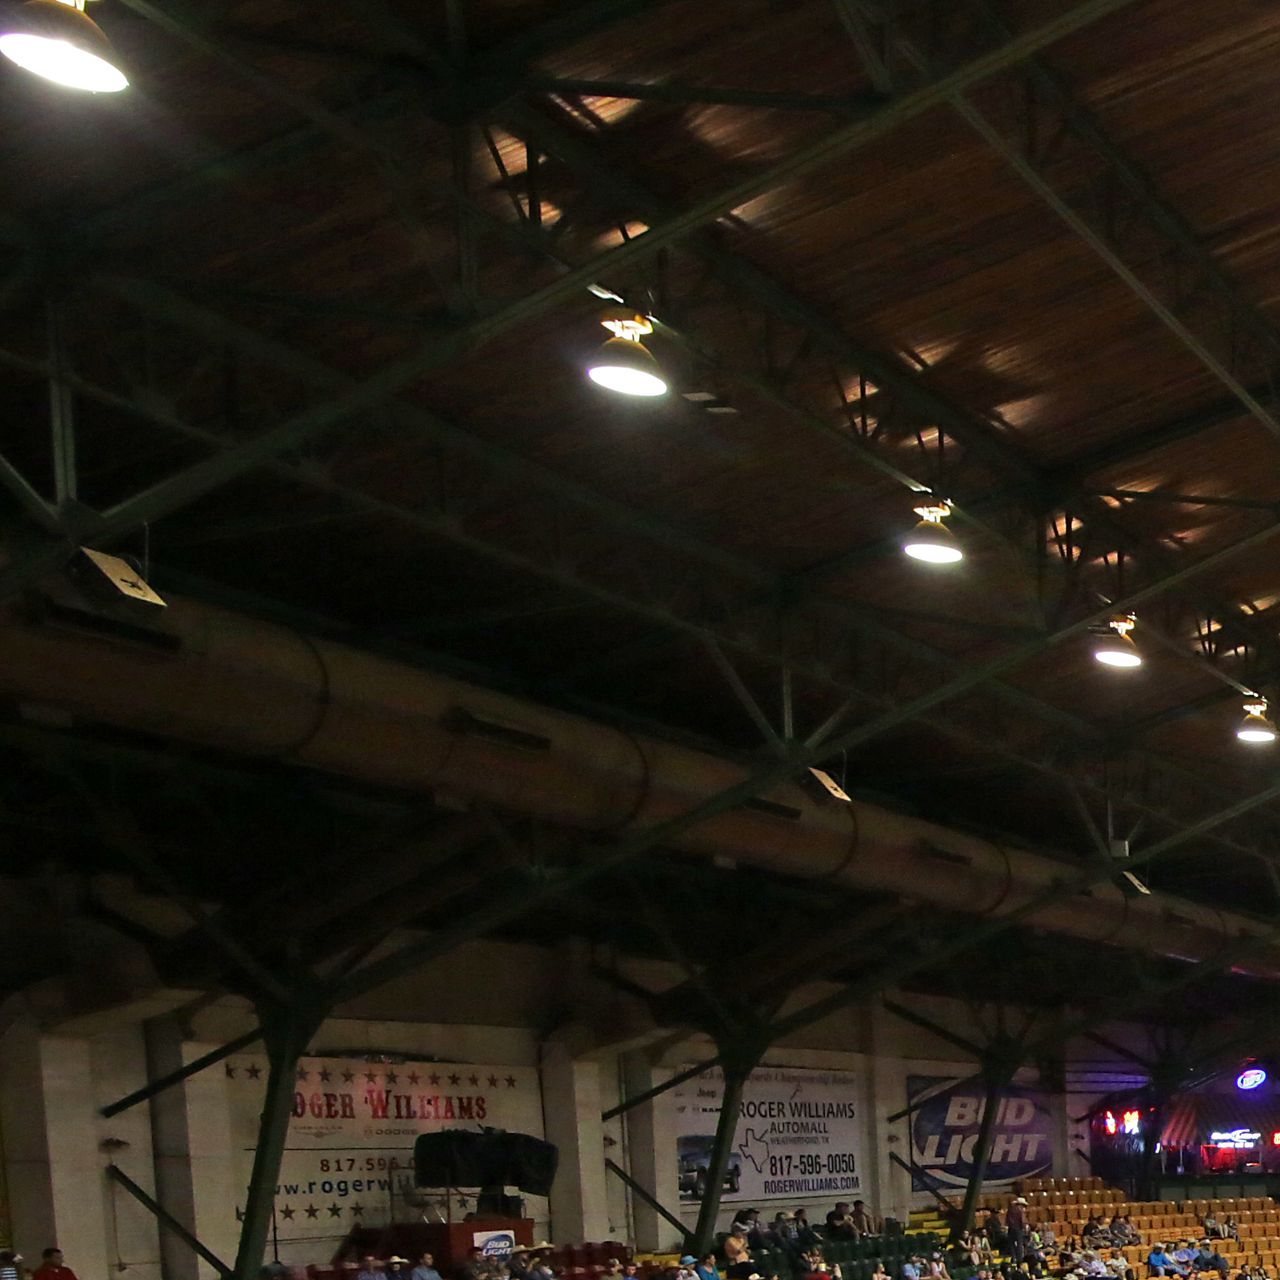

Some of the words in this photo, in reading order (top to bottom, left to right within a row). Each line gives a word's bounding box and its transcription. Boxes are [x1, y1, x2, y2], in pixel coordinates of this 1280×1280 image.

[292, 1091, 356, 1120] OGER
[365, 1089, 488, 1120] WILLIAMS
[738, 1101, 786, 1119] ROGER
[789, 1102, 856, 1119] WILLIAMS
[769, 1121, 829, 1135] AUTOMALL
[769, 1154, 856, 1176] 817-596-0050
[763, 1176, 860, 1195] ROGERWILLIAMS.COM
[481, 1246, 513, 1257] LIGHT
[484, 1239, 510, 1250] BUD
